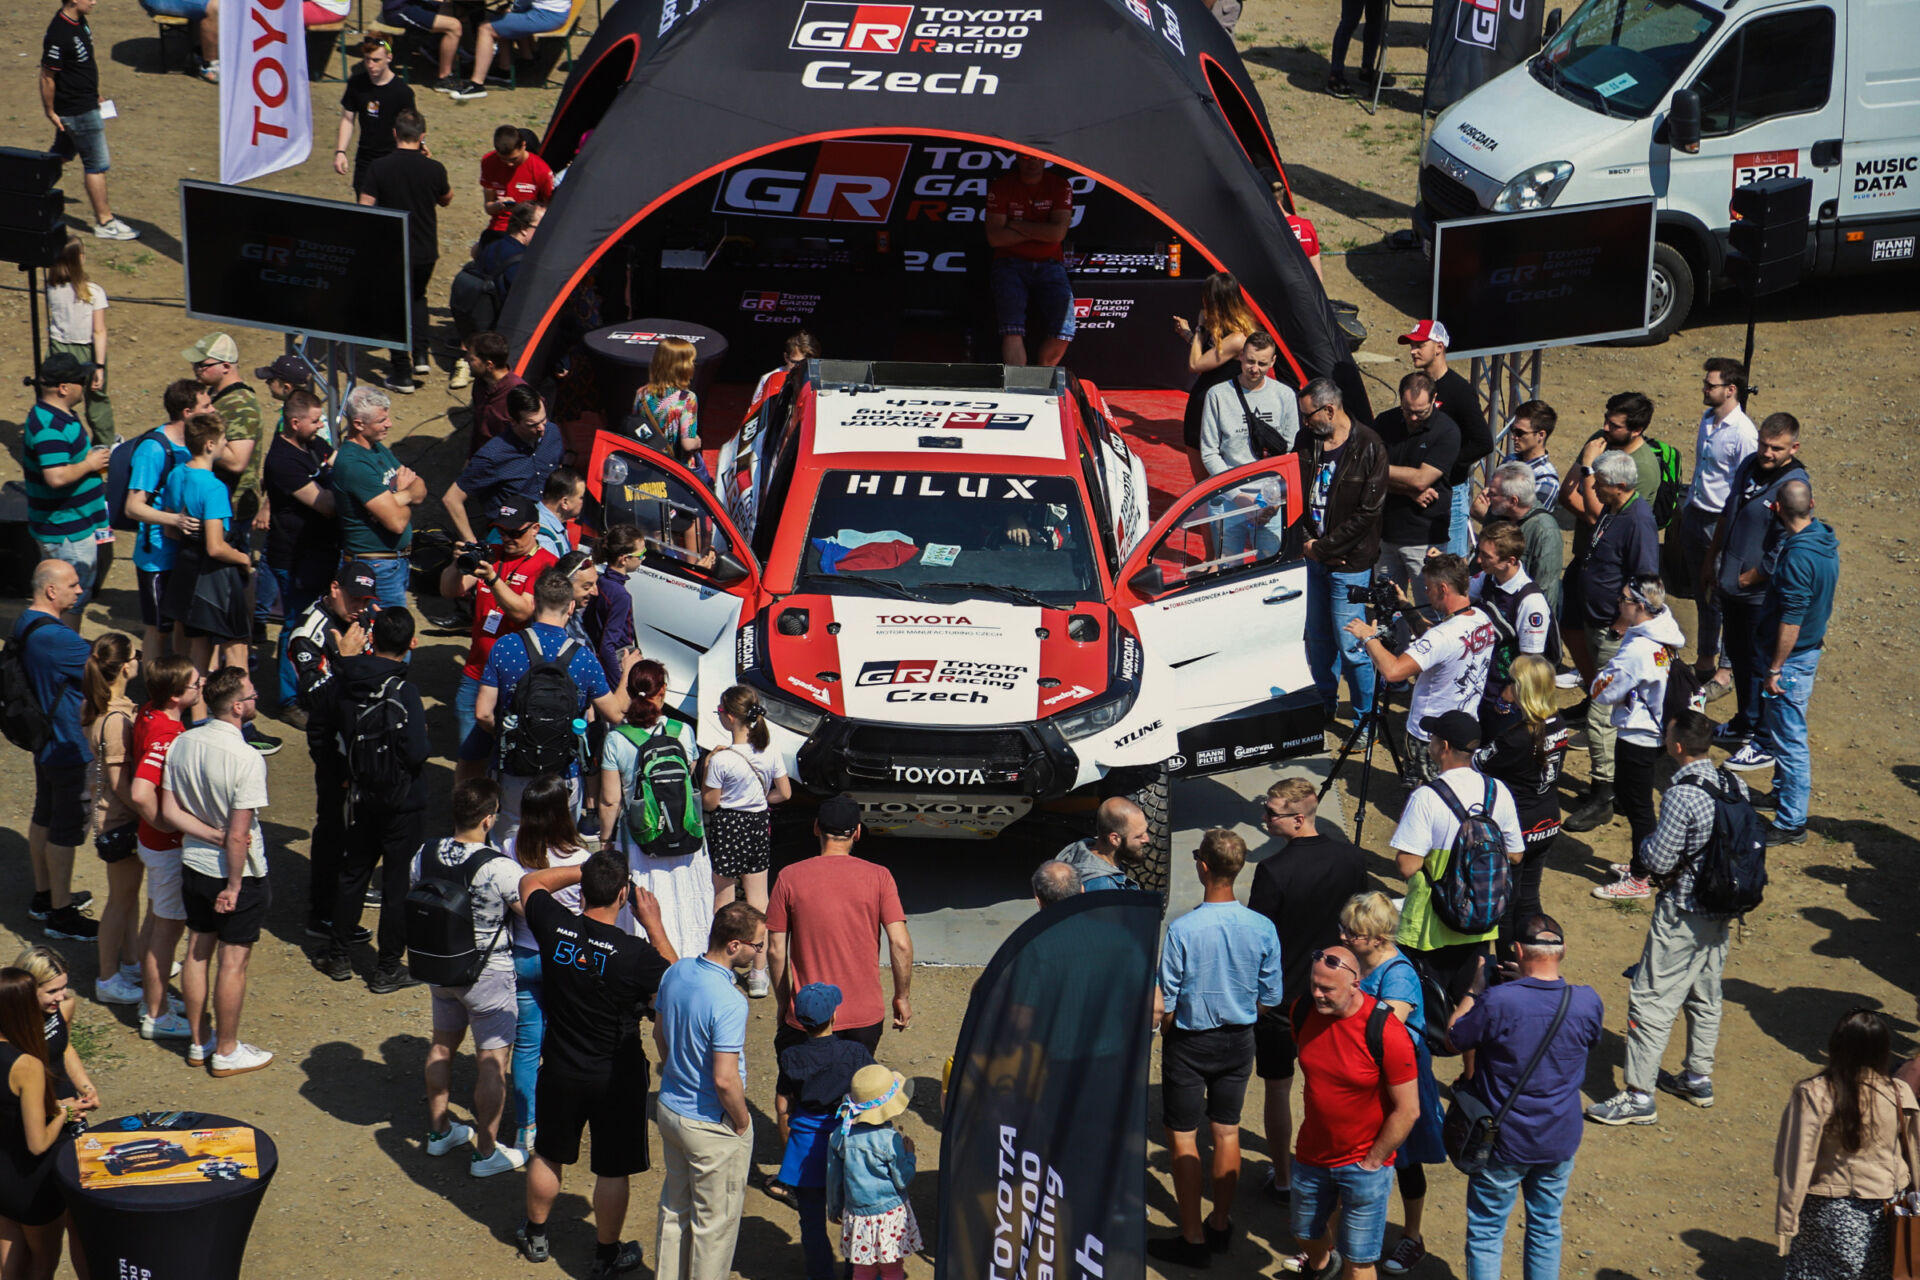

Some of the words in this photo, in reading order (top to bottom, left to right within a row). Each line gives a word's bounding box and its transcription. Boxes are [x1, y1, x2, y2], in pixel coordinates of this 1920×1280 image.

[920, 7, 1043, 22] TOYOTA
[797, 21, 902, 50] GR
[914, 23, 1030, 38] GAZOO
[909, 39, 1023, 59] Racing
[251, 0, 289, 146] TOY
[801, 60, 999, 95] Czech
[1457, 122, 1499, 152] MUSICDATA
[1855, 157, 1919, 176] MUSIC
[1741, 165, 1790, 185] 328
[1854, 174, 1908, 193] DATA
[724, 168, 891, 217] GR
[297, 240, 357, 255] TOYOTA
[1875, 239, 1913, 251] MANN
[1874, 248, 1912, 259] FILTER
[259, 268, 330, 289] Czech
[781, 293, 822, 301] TOYOTA
[753, 313, 802, 324] Czech
[886, 399, 999, 410] Czech
[856, 408, 943, 417] Racing
[949, 412, 1031, 424] GR
[840, 420, 936, 428] TOYOTA
[846, 474, 1038, 499] HILUX
[876, 615, 973, 625] TOYOTA
[743, 625, 754, 670] MUSICDATA
[1122, 637, 1135, 680] MUSICDATA
[940, 668, 1020, 680] GAZOO
[943, 660, 1029, 673] TOYOTA
[858, 668, 932, 685] GR
[937, 675, 1015, 690] Racing
[886, 689, 989, 704] Czech
[1114, 720, 1163, 749] XTLINE
[1283, 739, 1300, 748] PNEU
[1300, 733, 1324, 745] KAFKA
[1168, 758, 1182, 766] ELL
[1198, 755, 1225, 765] FILTER
[1199, 750, 1225, 759] MANN
[892, 766, 986, 785] TOYOTA
[857, 802, 1014, 816] TOYOTA
[1527, 826, 1560, 843] HILUX
[1016, 1151, 1041, 1280] AZOO
[1038, 1165, 1064, 1280] acing
